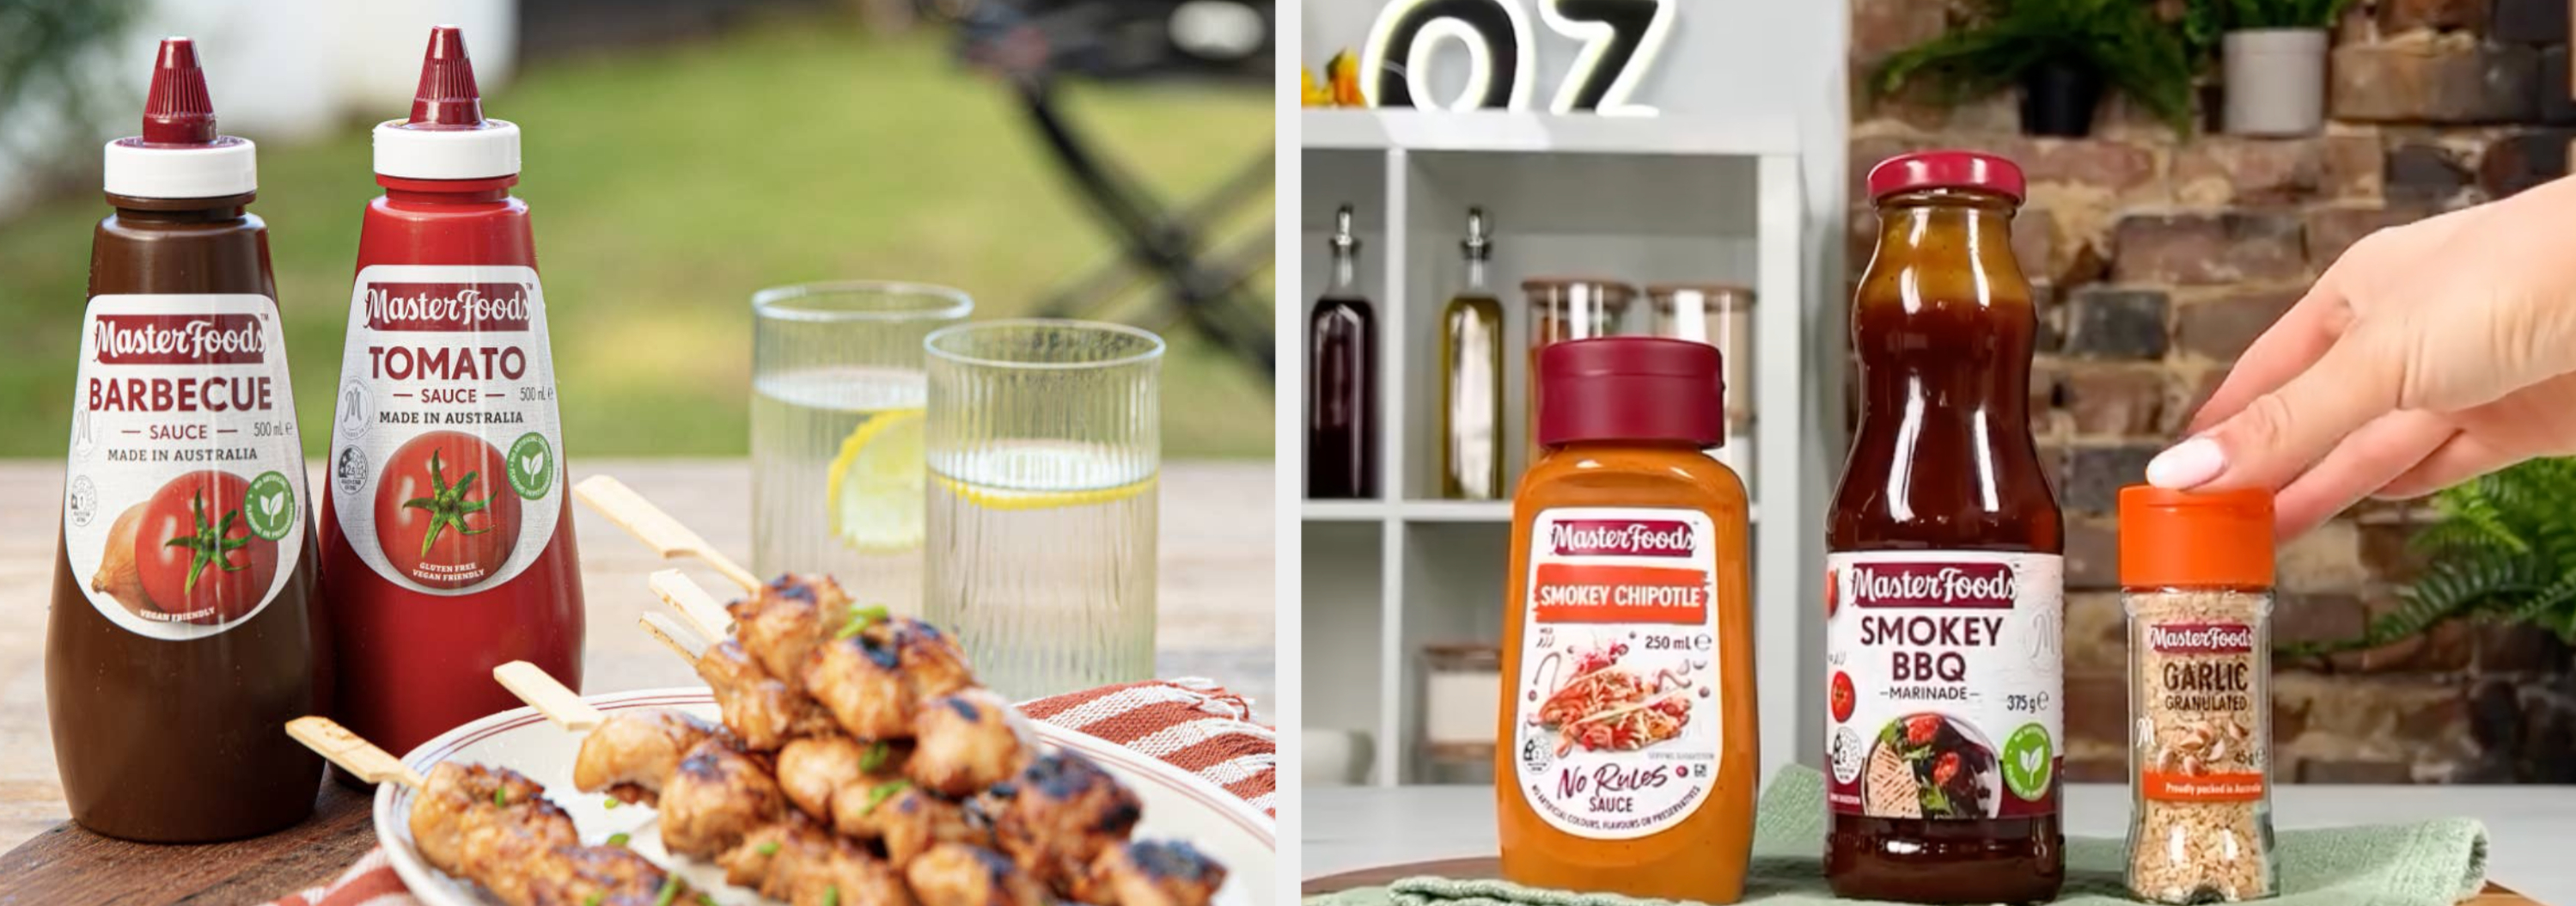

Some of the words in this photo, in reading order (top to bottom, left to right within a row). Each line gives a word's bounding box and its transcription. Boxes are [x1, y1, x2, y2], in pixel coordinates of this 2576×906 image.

[363, 288, 531, 328] MasterFoods
[92, 320, 266, 362] MasterFoods
[369, 346, 527, 381] TOMATO
[89, 376, 272, 412] BARBECUE
[421, 388, 477, 404] SAUCE
[520, 386, 536, 401] 500
[379, 411, 419, 424] MADE
[423, 412, 440, 424] IN
[445, 411, 524, 424] AUSTRALIA
[150, 425, 208, 439] SAUCE
[253, 421, 272, 437] 500
[107, 448, 149, 462] MADE
[152, 448, 169, 461] IN
[174, 447, 258, 462] AUSTRALIA
[1547, 523, 1696, 555] MasterFoods
[412, 568, 442, 581] VEGAN
[443, 568, 485, 581] FRIENDLY
[419, 561, 453, 573] GLUTEN
[454, 561, 477, 572] FREE
[1850, 566, 2017, 607] MasterFoods
[1541, 584, 1609, 607] SMOKEY
[1614, 585, 1701, 608] CHIPOTLE
[139, 608, 170, 621] VEGAN
[171, 606, 215, 622] FRIENDLY
[1860, 616, 2005, 646] SMOKEY
[2149, 626, 2253, 651] MasterFoods
[1645, 634, 1670, 650] 250
[1892, 652, 1967, 682] BBQ
[2164, 661, 2249, 691] GARLIC
[1889, 687, 1968, 701] MARINADE
[2165, 695, 2248, 711] GRANULATED
[2006, 695, 2028, 711] 375
[2030, 698, 2036, 713] g
[1557, 764, 1588, 800] No
[1538, 793, 1567, 821] ARTIFICIAL
[1651, 785, 1701, 823] PRESERVATIVES
[1589, 796, 1633, 812] SAUCE
